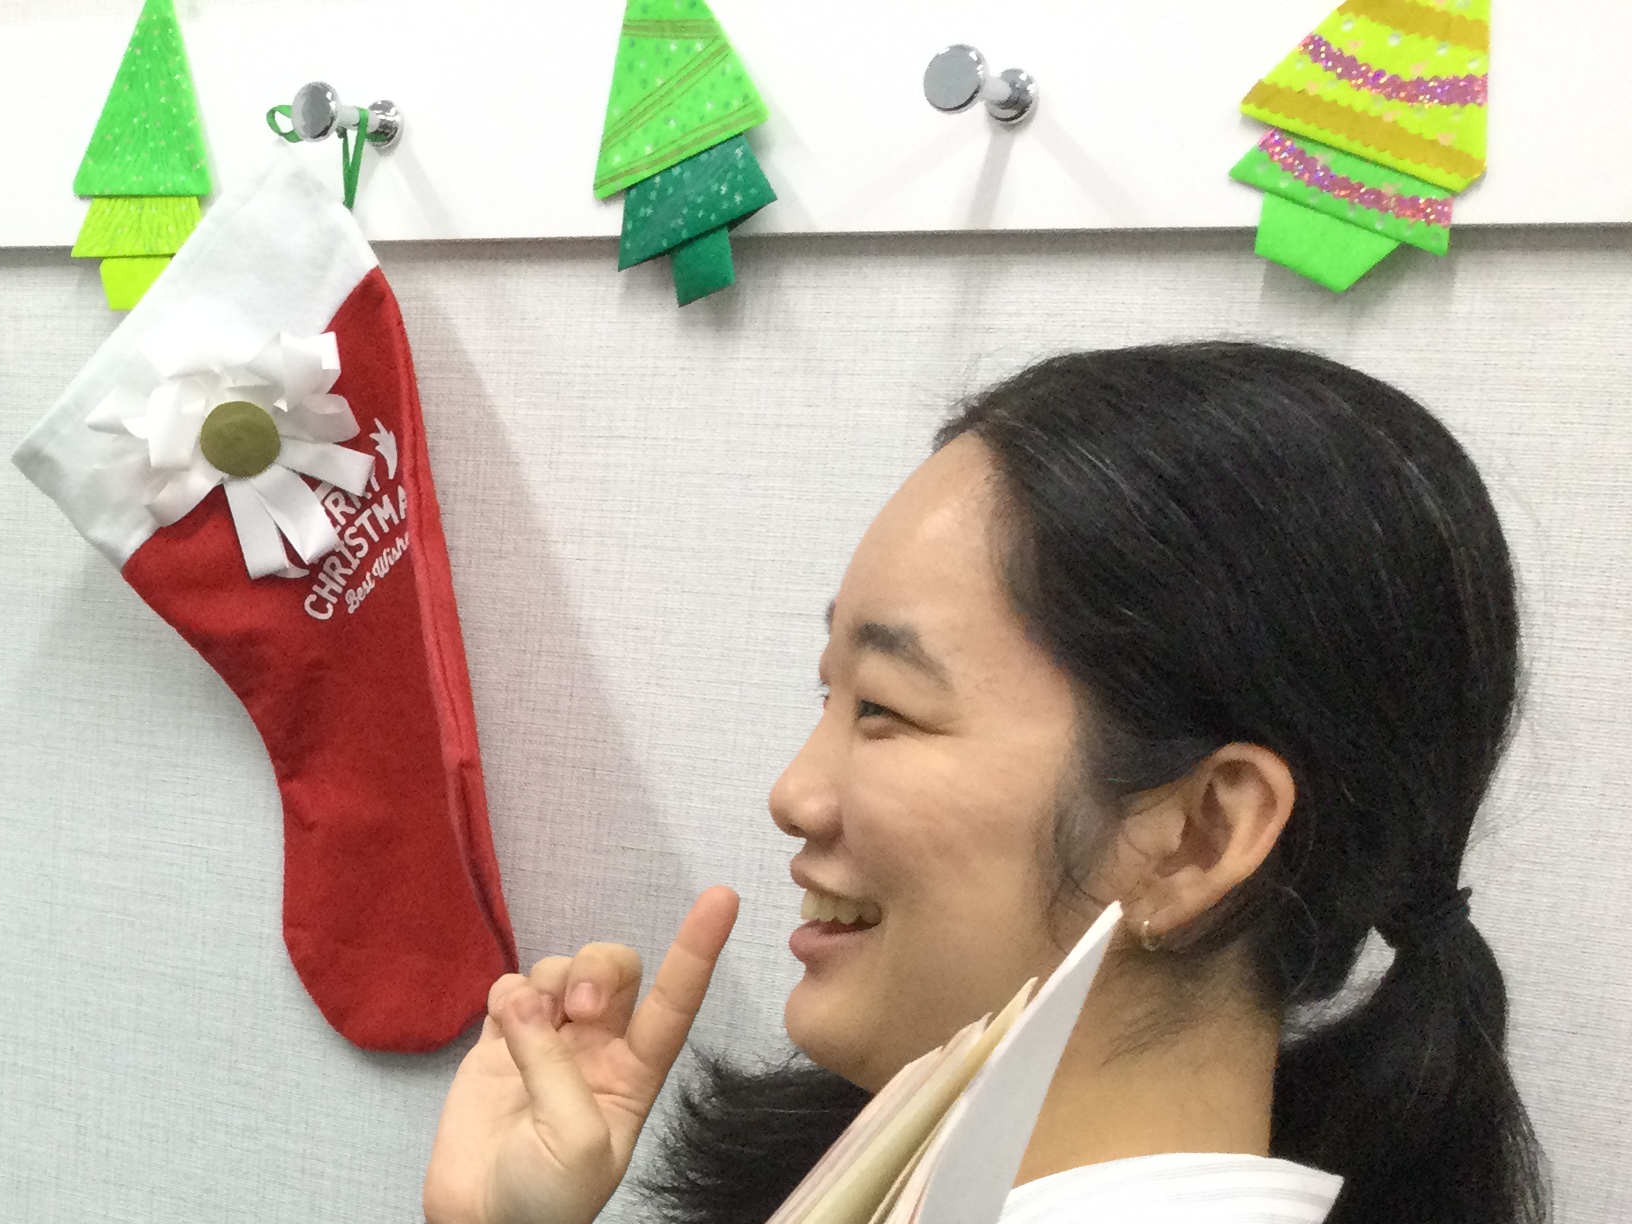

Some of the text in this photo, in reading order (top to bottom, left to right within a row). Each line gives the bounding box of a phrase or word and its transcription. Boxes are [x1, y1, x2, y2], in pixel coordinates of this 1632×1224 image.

[304, 485, 408, 620] CHRISTMA
[345, 532, 409, 614] Best Wish
